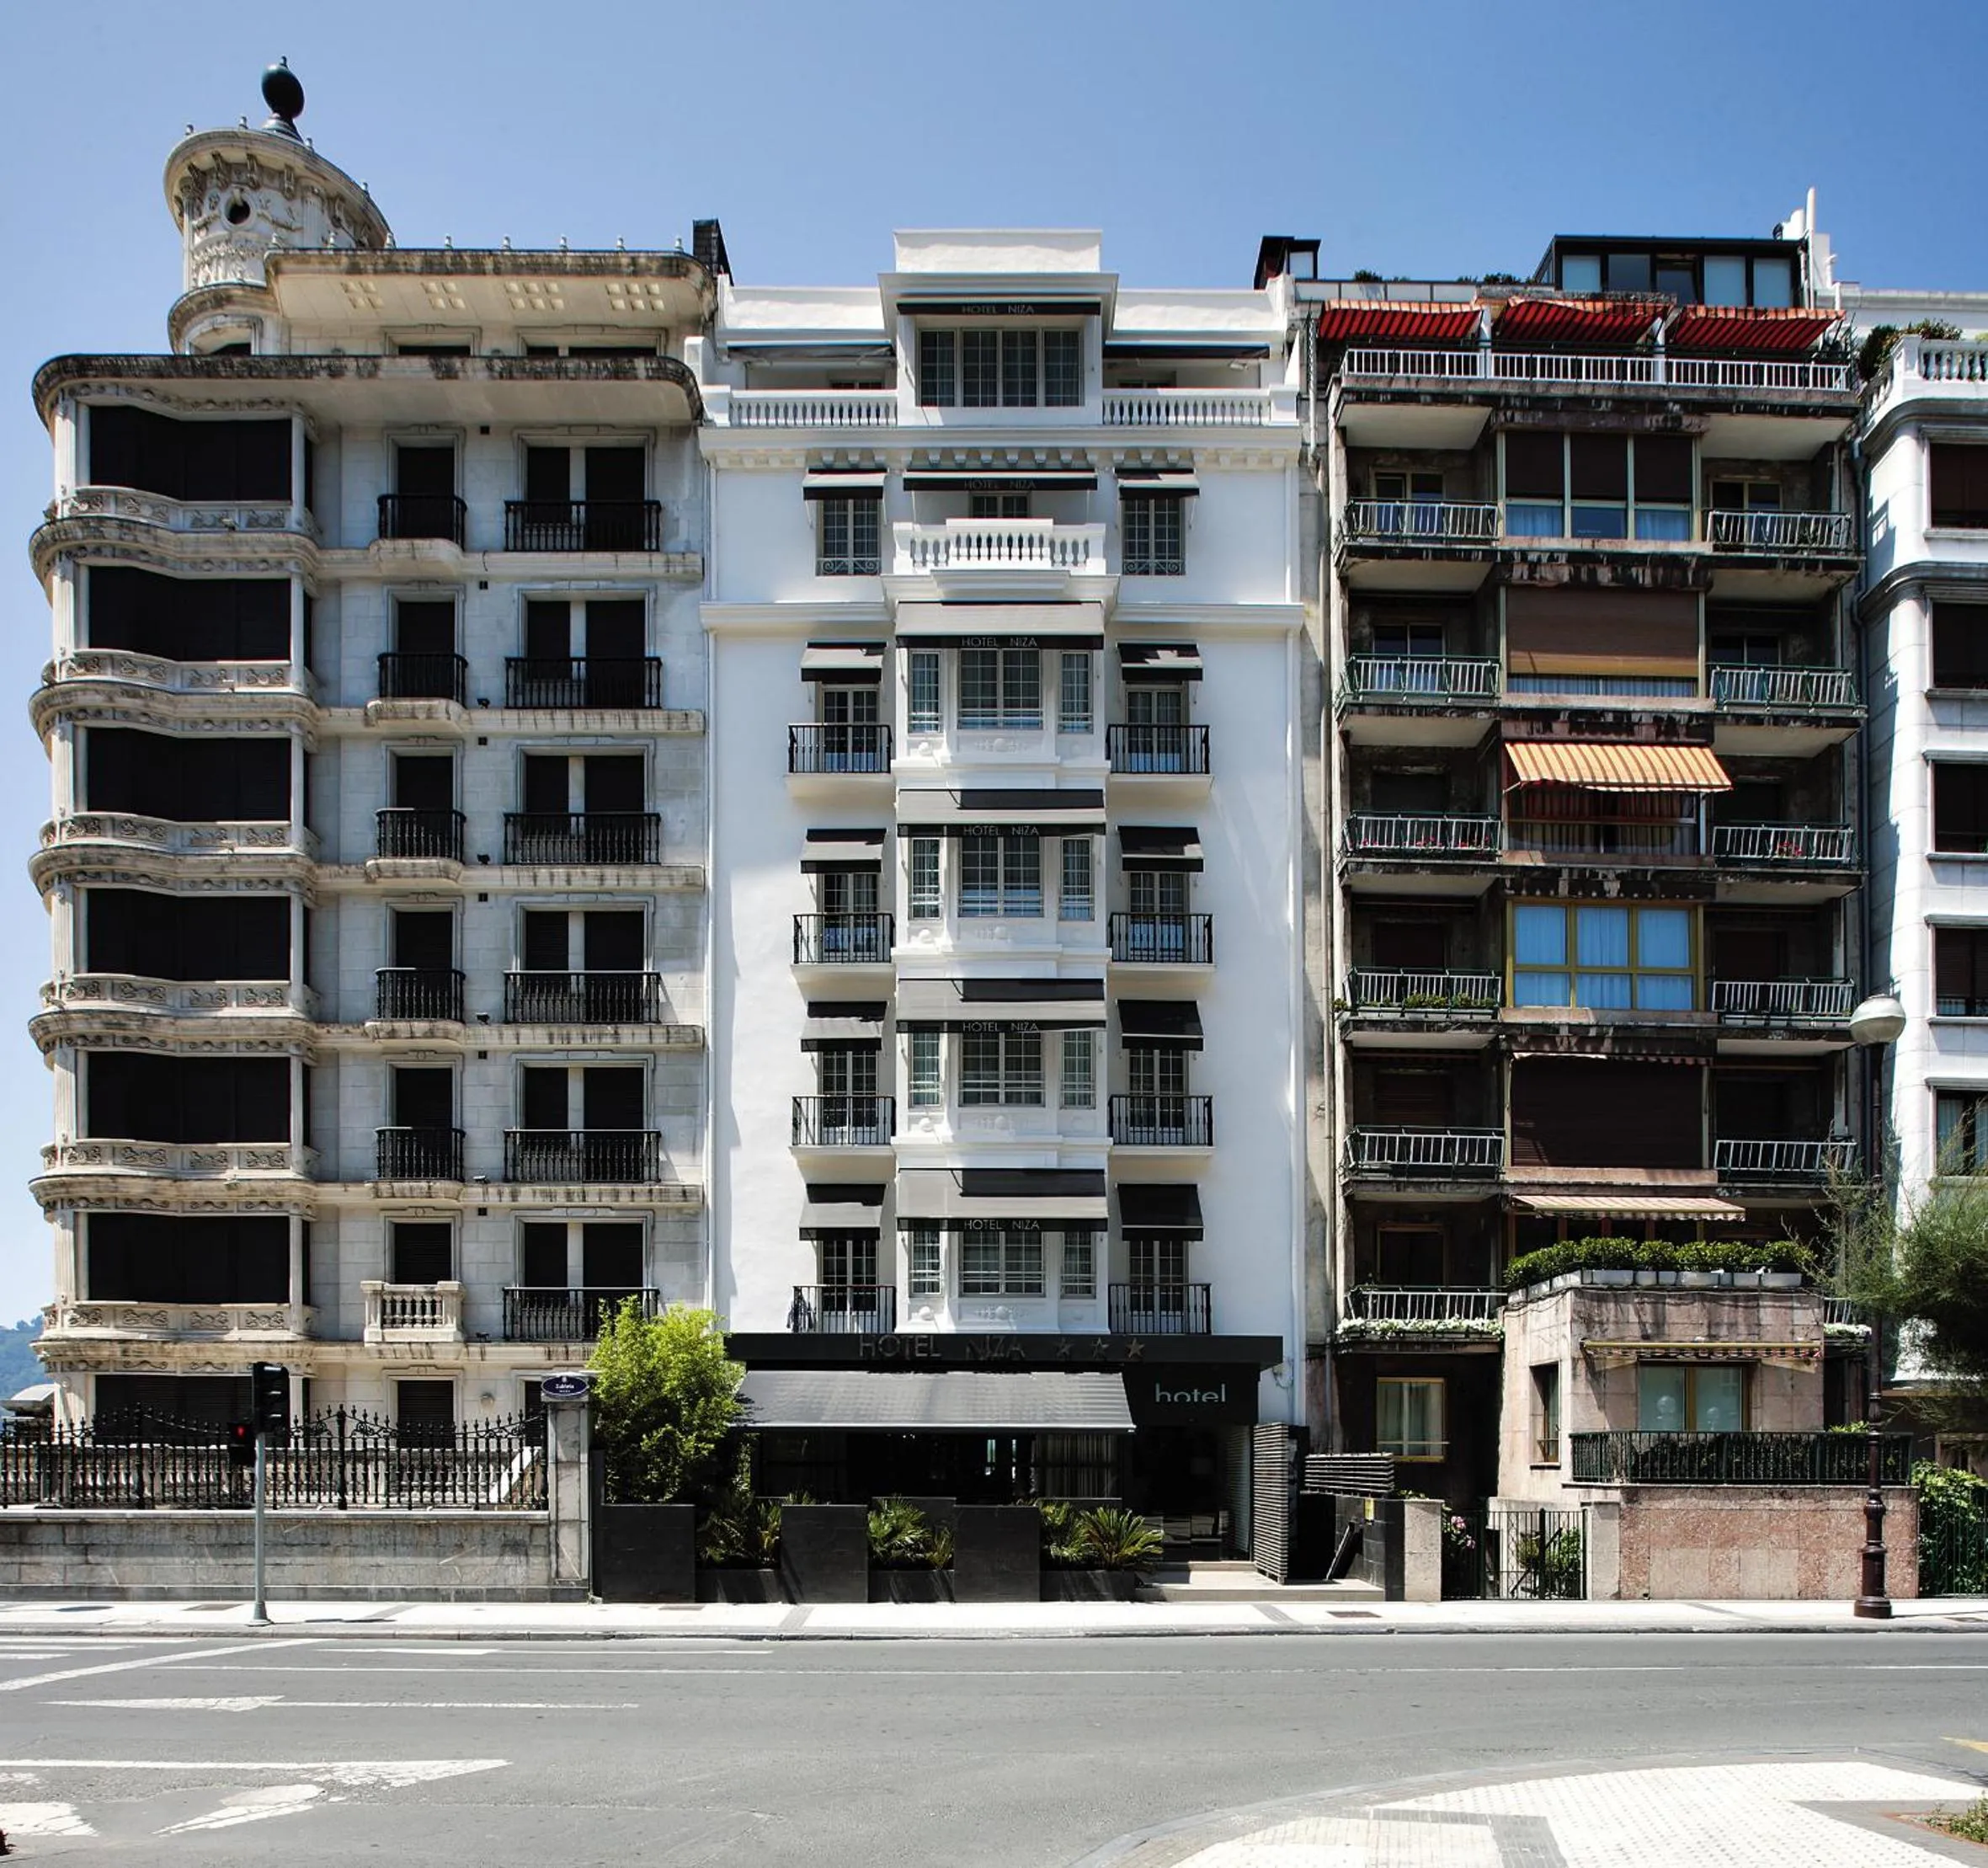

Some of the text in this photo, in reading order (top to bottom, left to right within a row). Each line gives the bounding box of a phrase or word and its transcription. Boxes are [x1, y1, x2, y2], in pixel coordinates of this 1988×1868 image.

[961, 638, 1037, 647] HOTEL NIZA
[963, 826, 1040, 835] HOTEL NIZA
[962, 1022, 1039, 1032] HOTEL NIZA
[964, 1220, 1040, 1230] HOTEL NIZA
[859, 1334, 1026, 1358] HOTEL NIZA
[1155, 1383, 1226, 1402] hotel
